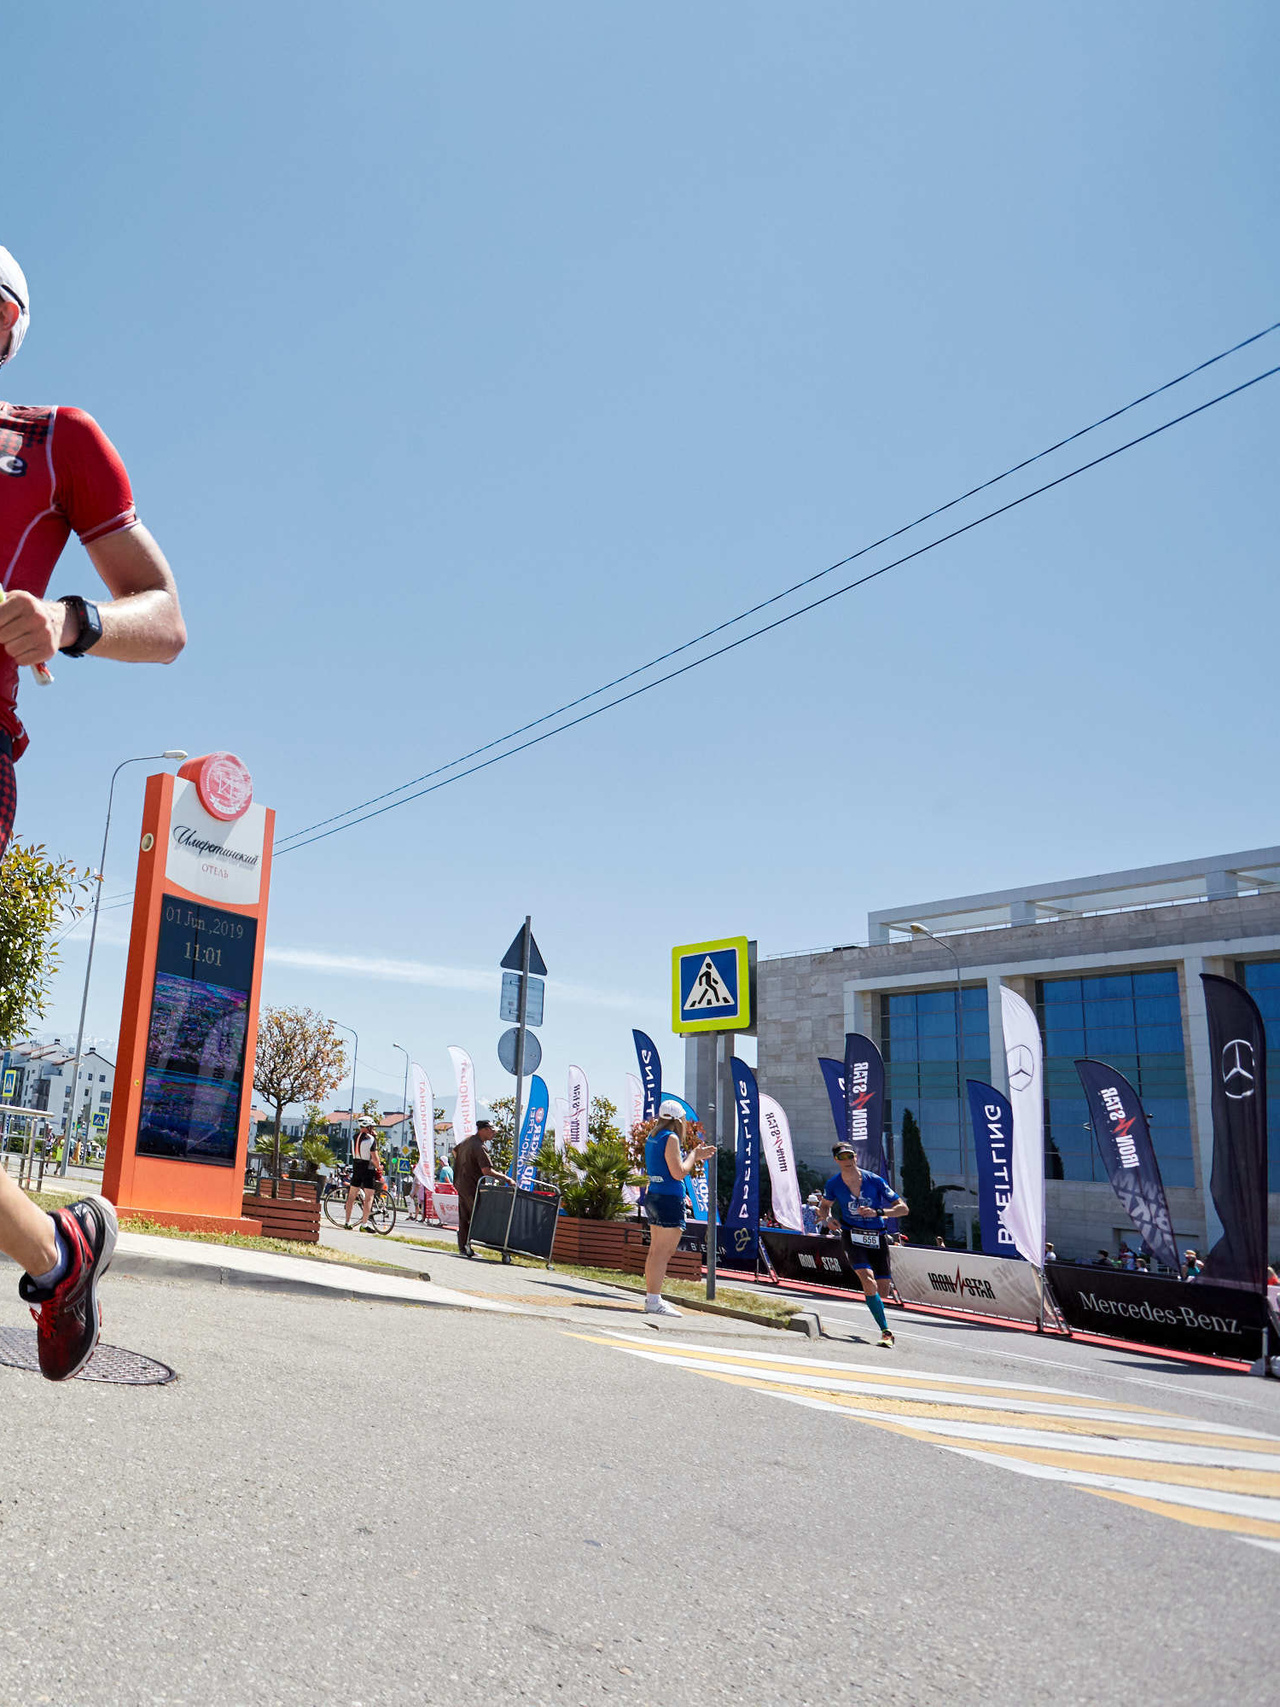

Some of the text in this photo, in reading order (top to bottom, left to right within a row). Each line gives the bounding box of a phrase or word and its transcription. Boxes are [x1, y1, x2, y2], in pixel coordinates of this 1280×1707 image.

[172, 825, 259, 866] Имеретинский
[201, 863, 229, 880] ОТЕЛЬ
[166, 906, 181, 924] 01
[184, 942, 222, 967] 11:01
[798, 1253, 842, 1273] IRON STAR
[928, 1272, 997, 1300] IRON STAR
[1077, 1291, 1242, 1335] Mercedes-Benz
